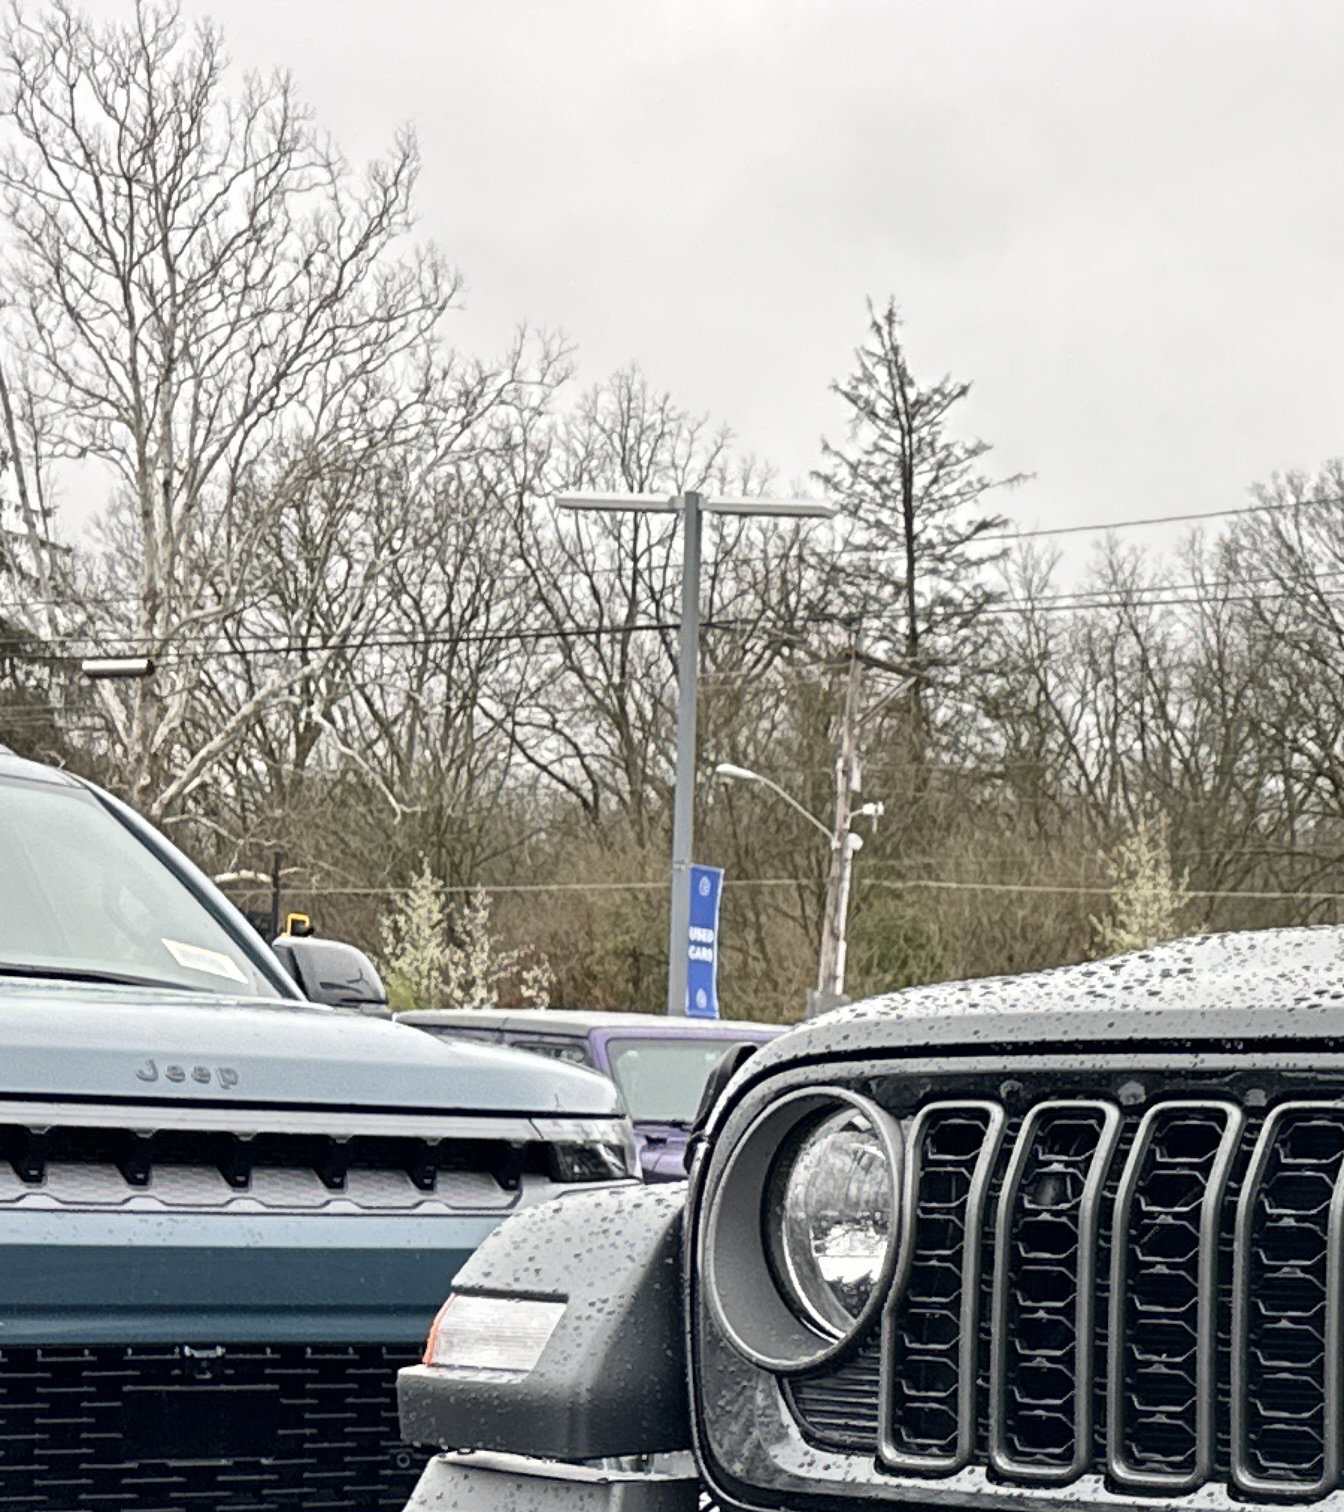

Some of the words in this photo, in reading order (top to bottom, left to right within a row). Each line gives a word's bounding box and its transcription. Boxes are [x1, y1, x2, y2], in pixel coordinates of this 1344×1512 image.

[689, 926, 714, 944] USED
[688, 945, 713, 963] CARS
[136, 1059, 239, 1090] Jeep
